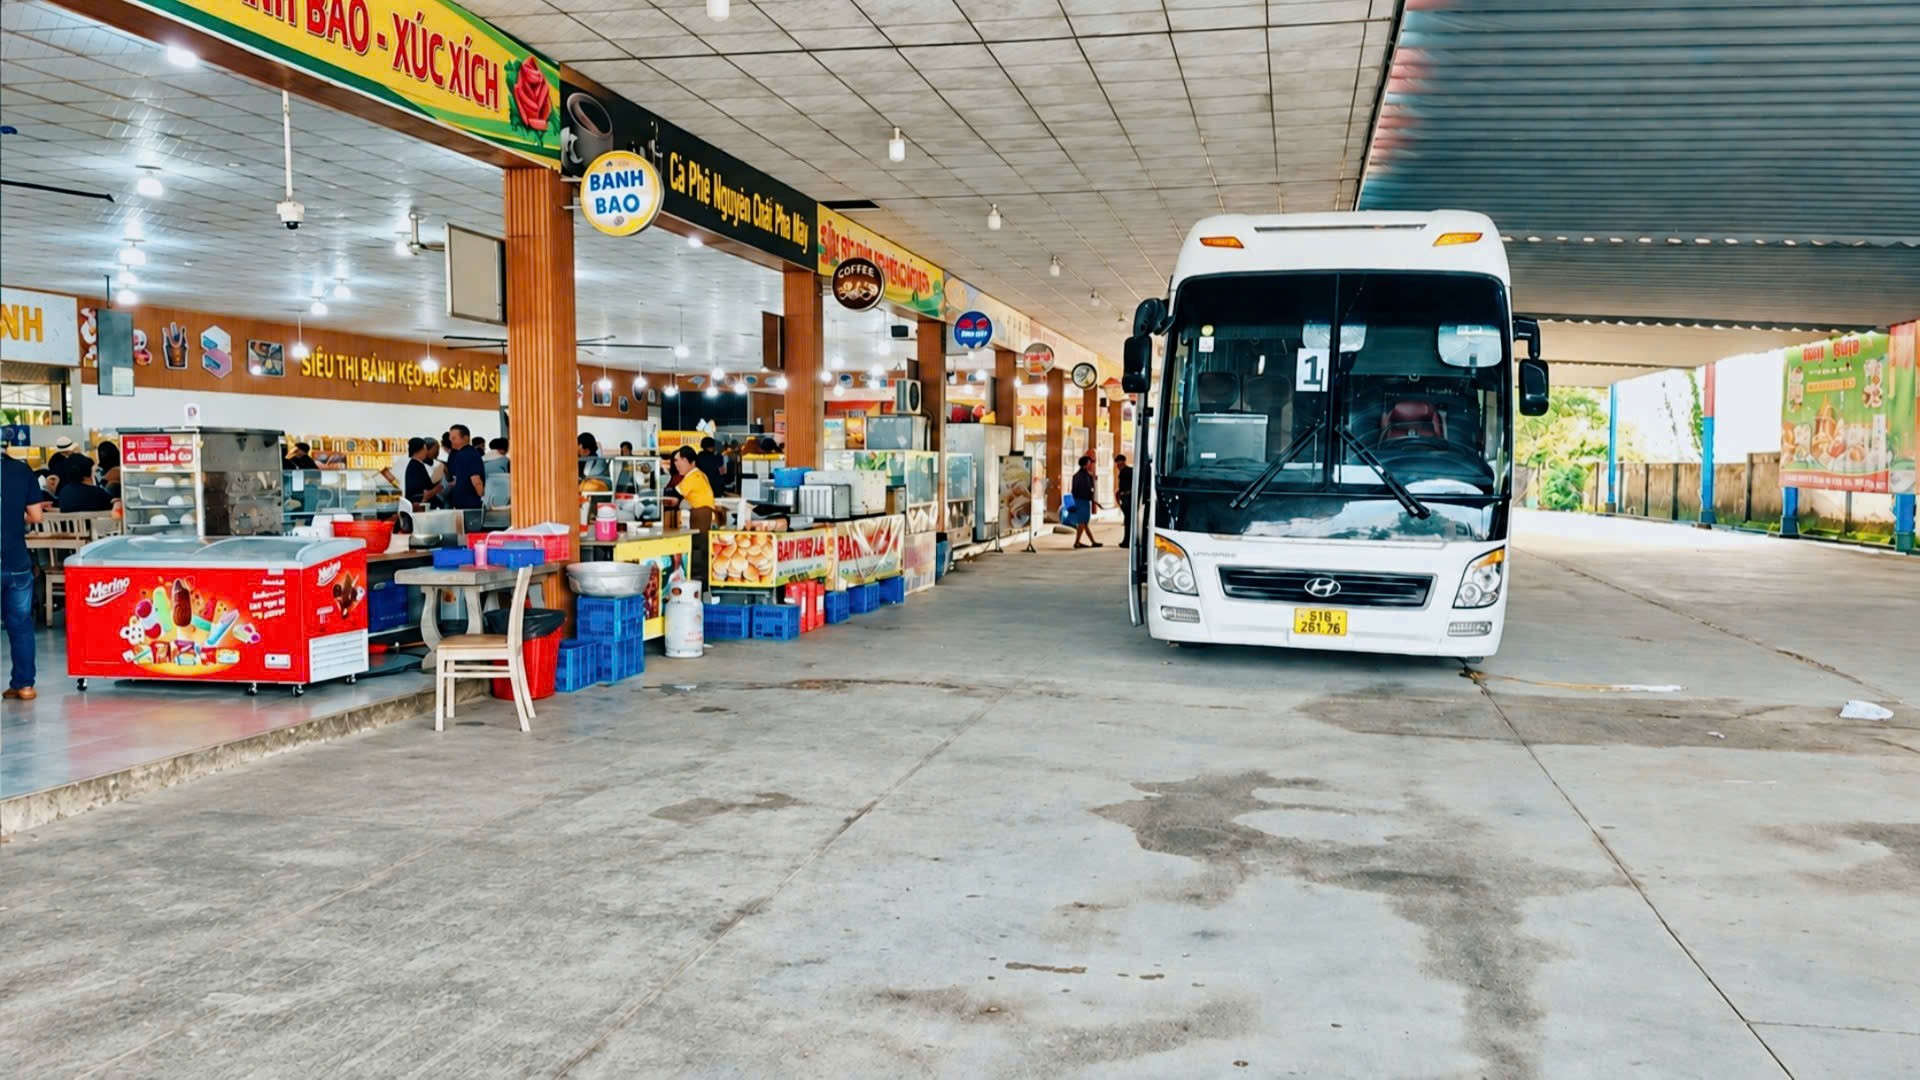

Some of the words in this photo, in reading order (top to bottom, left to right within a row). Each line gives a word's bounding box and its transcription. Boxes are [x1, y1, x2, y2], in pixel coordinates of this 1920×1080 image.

[392, 10, 445, 88] XÚC
[448, 35, 500, 111] XÍCH
[595, 193, 640, 215] BAO
[838, 265, 875, 278] COFFEE
[301, 345, 334, 379] SIÊU
[336, 354, 360, 387] THỊ
[1304, 356, 1321, 385] 1
[88, 576, 131, 600] Merino
[1300, 621, 1341, 634] 261.76
